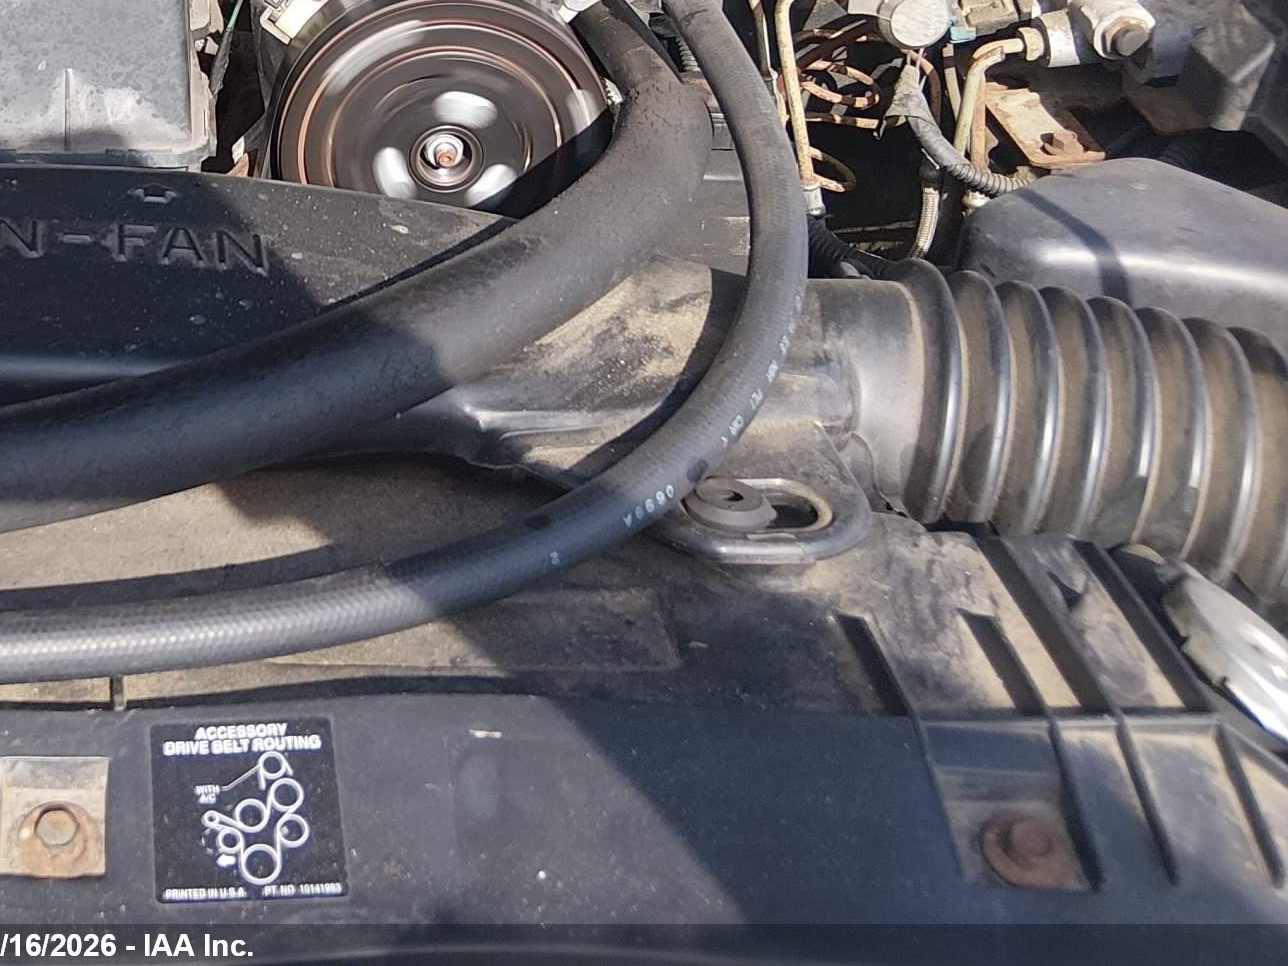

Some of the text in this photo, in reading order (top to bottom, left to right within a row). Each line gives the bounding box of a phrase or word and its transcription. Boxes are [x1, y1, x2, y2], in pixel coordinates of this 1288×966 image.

[194, 722, 287, 740] ACCESSORY
[163, 735, 322, 756] DRIVE BELT ROUTING
[194, 785, 220, 795] WITH
[165, 888, 206, 901] PRINTED
[207, 888, 218, 899] IN
